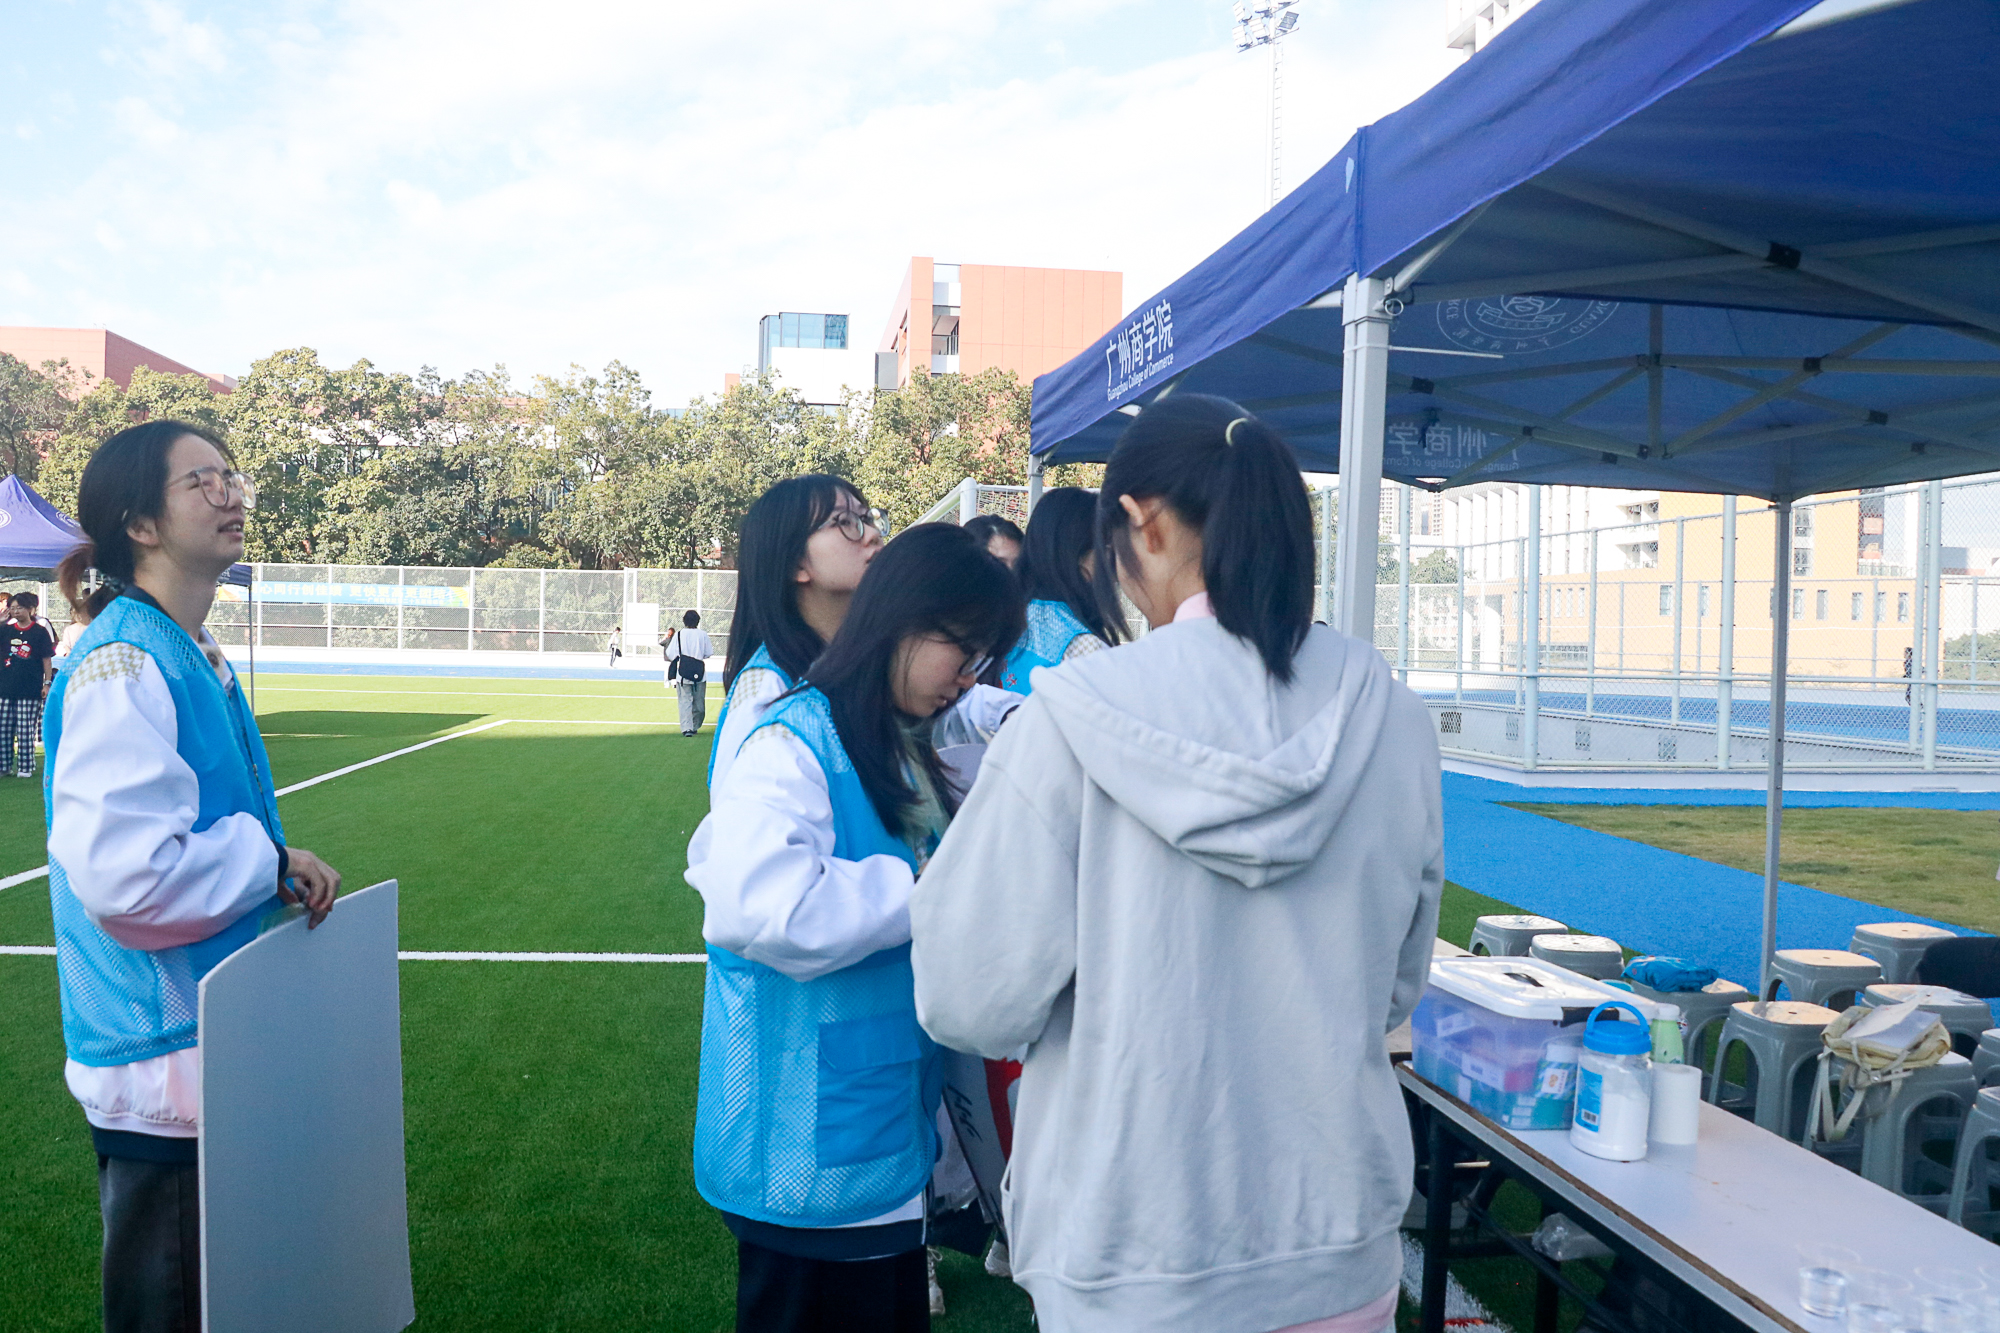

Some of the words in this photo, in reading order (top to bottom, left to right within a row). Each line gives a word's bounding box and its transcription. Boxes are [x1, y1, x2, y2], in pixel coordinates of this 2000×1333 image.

[1106, 299, 1174, 387] 广州商学院
[1107, 381, 1129, 401] Guangzhou
[1129, 371, 1144, 389] College
[1143, 363, 1149, 380] of
[1149, 353, 1174, 377] Commerce
